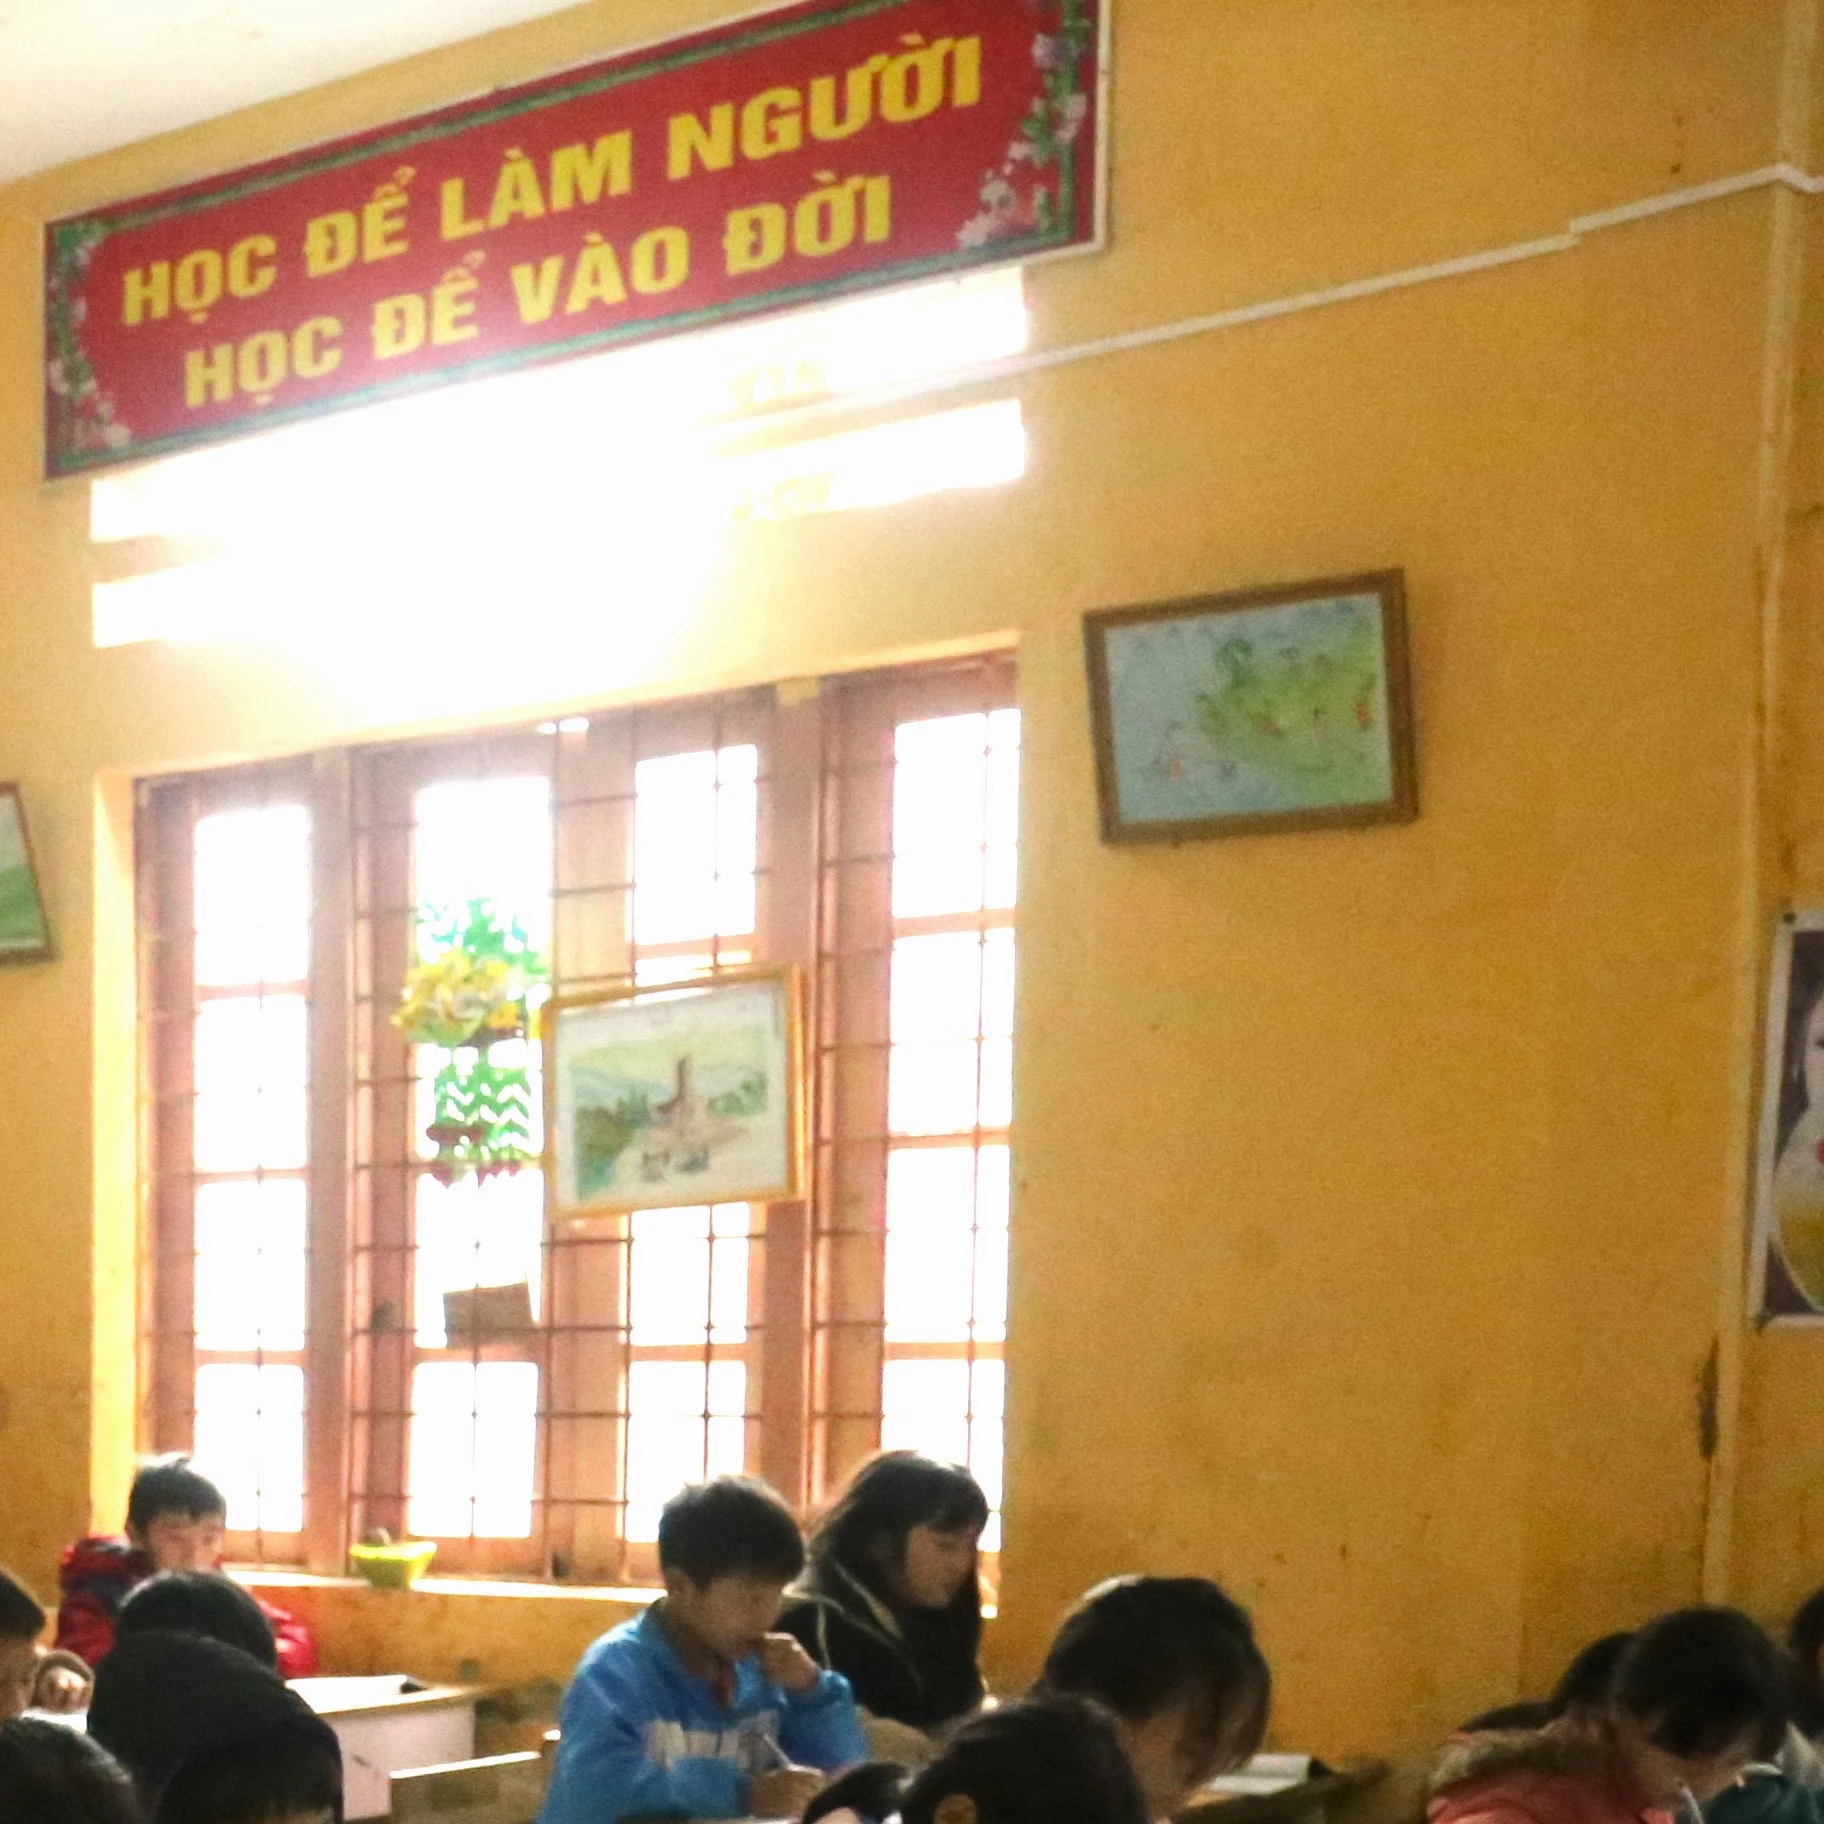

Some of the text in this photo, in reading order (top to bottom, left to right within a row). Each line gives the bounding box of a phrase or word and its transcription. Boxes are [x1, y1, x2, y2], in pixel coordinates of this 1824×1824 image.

[120, 32, 981, 325] HỌC ĐỂ LÀM NGƯỜI
[184, 171, 891, 408] HỌC ĐỂ VÀO ĐỜI
